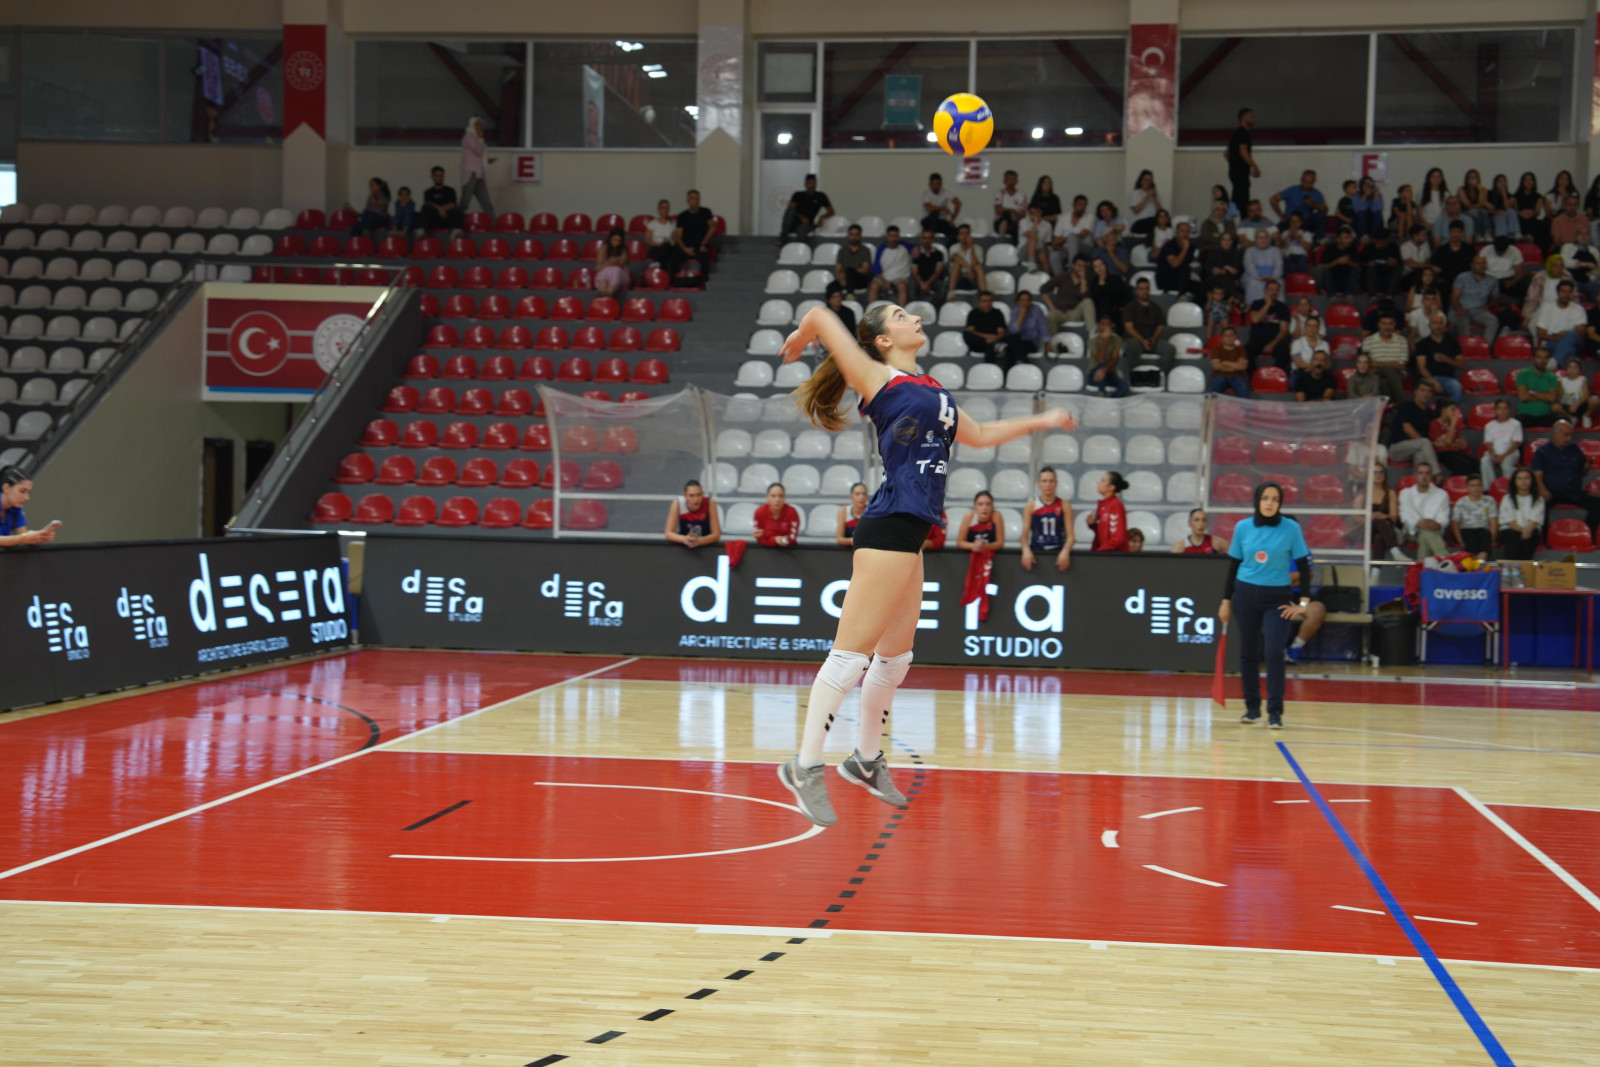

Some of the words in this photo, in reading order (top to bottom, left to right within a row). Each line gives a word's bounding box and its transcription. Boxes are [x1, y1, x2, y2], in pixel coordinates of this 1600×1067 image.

[517, 156, 535, 178] E
[963, 157, 981, 180] E
[1362, 155, 1379, 178] F
[938, 392, 955, 430] 4
[1041, 516, 1056, 537] 11
[1433, 587, 1488, 600] avessa
[310, 618, 348, 644] STUDIO
[678, 634, 777, 650] ARCHITECTURE
[778, 637, 790, 650] &
[791, 638, 834, 651] SPATIA
[964, 635, 1063, 659] STUDIO
